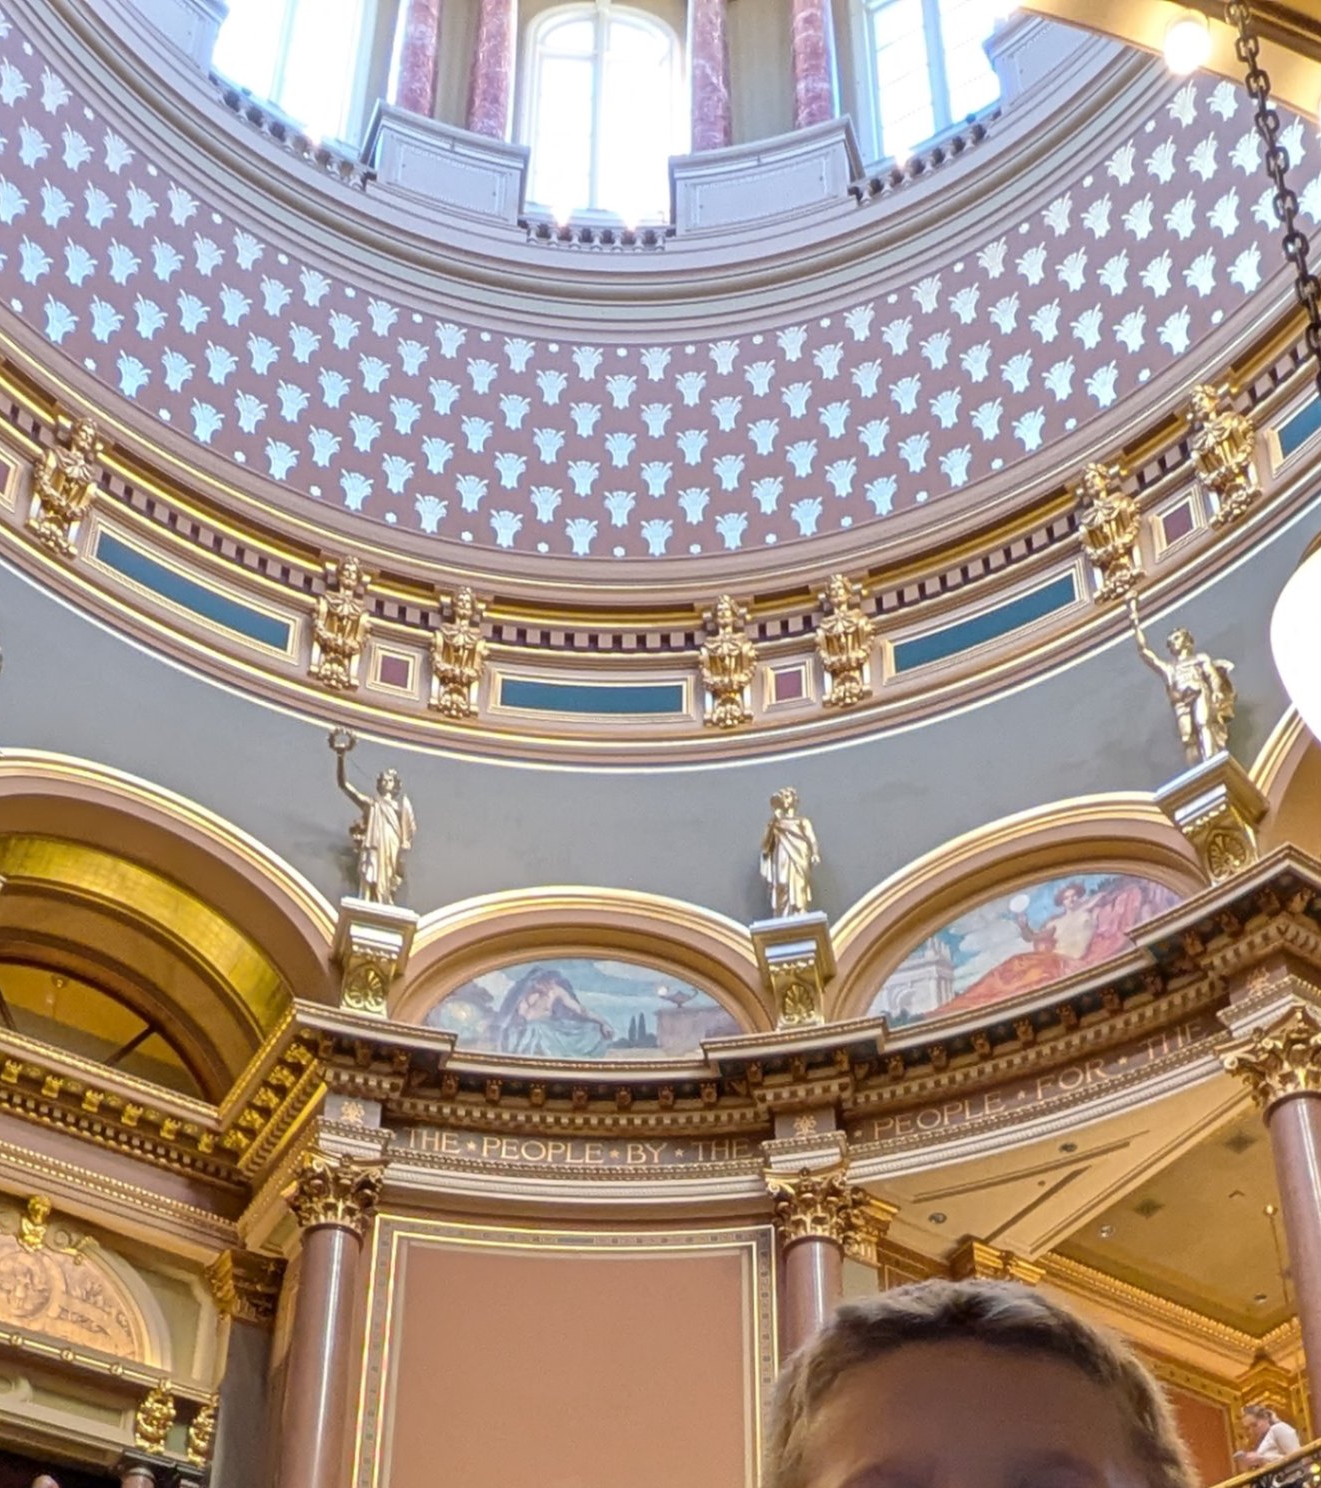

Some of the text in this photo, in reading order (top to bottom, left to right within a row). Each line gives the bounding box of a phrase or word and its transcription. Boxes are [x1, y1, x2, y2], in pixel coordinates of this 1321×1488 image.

[873, 1090, 1008, 1141] PEOPLE
[1035, 1058, 1112, 1101] FOR
[402, 1126, 754, 1164] THE PEOPLE BY THE
